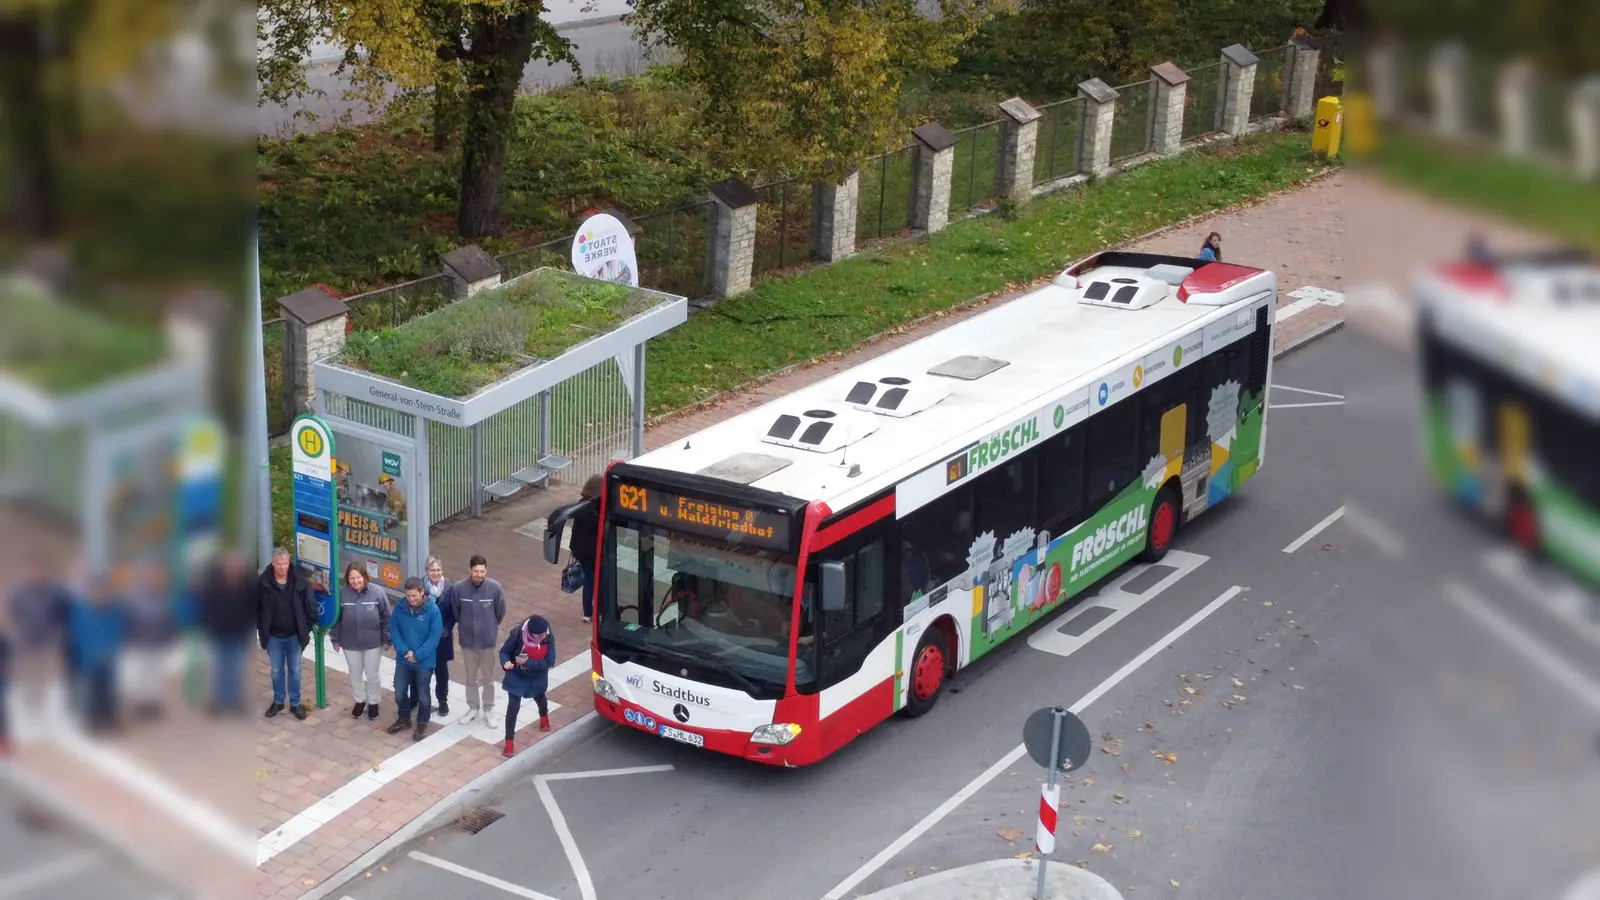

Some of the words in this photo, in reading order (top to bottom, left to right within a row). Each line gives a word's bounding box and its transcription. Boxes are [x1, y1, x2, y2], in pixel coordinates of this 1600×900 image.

[369, 386, 461, 420] General-von-Stein-Straße
[304, 431, 316, 453] H
[968, 416, 1040, 474] FRÖSCHL
[619, 484, 648, 513] 621
[677, 496, 740, 521] Freising
[677, 508, 775, 538] Waldfriedhof
[345, 529, 398, 553] LEISTUNG
[1071, 503, 1146, 572] FRÖSCHL
[653, 680, 710, 707] Stadtbus
[688, 733, 702, 745] 632
